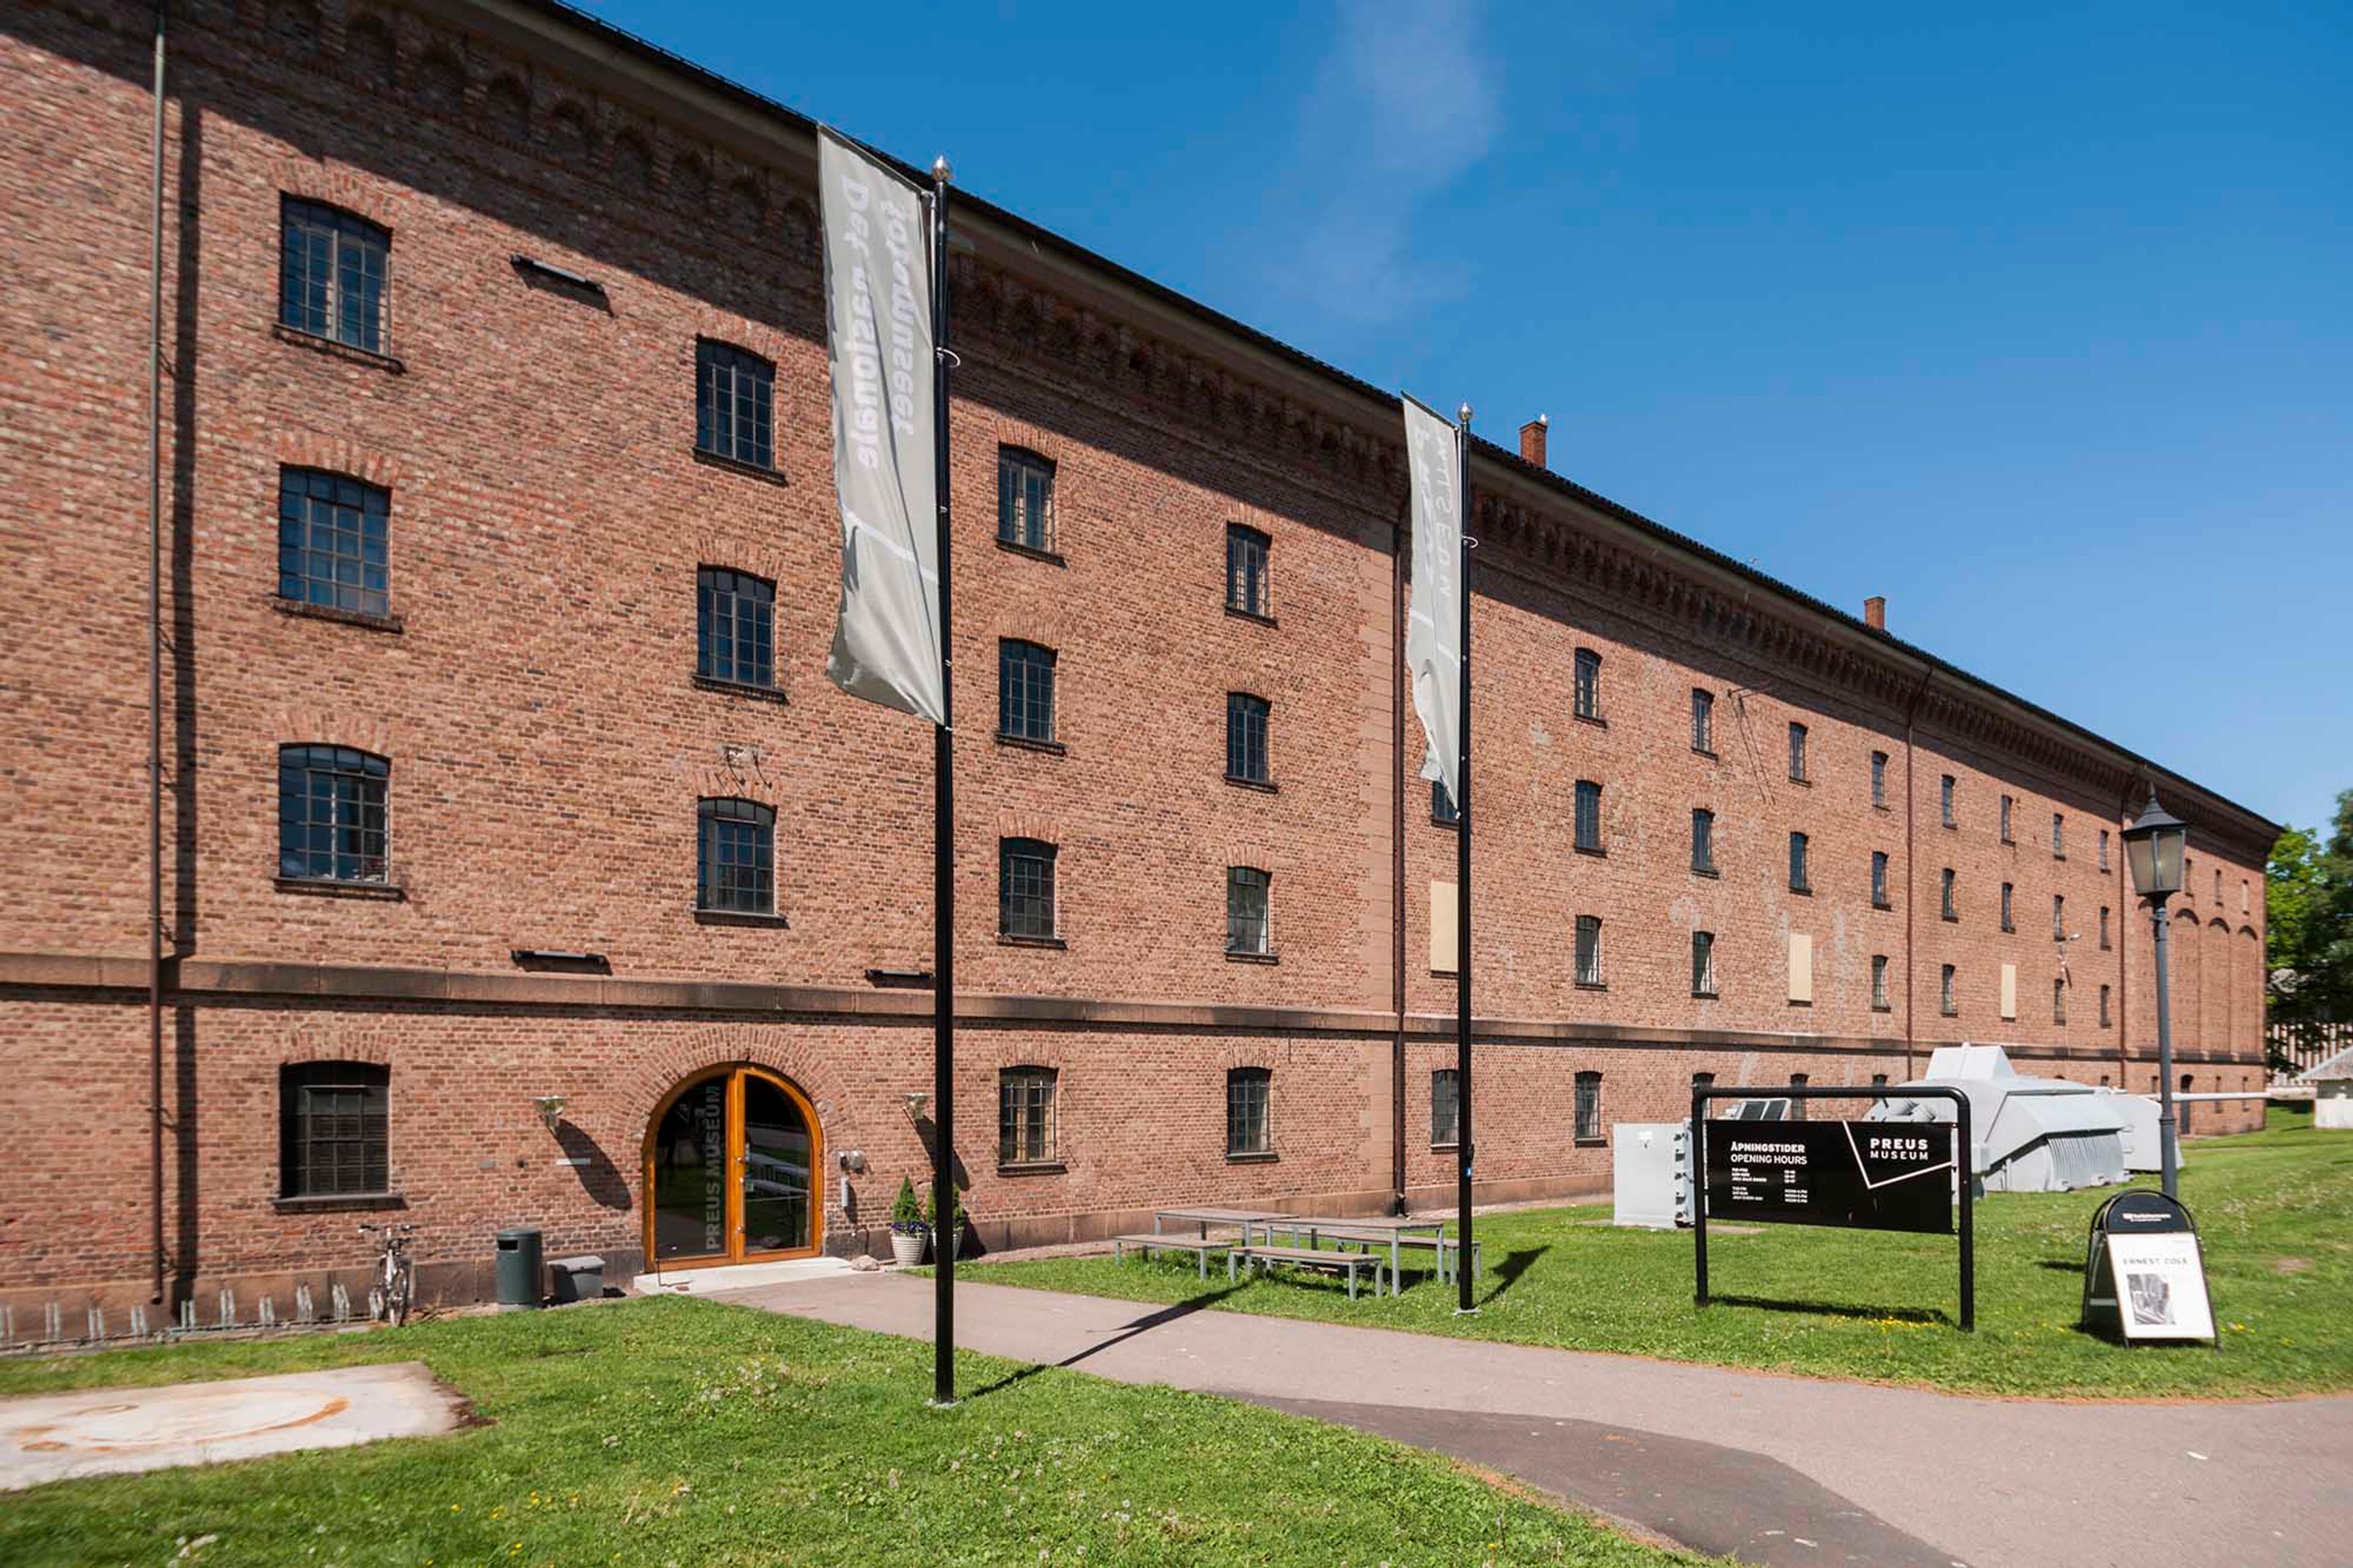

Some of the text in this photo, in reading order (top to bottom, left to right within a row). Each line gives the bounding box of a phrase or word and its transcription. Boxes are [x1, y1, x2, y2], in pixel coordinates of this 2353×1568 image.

[1870, 1138, 1928, 1150] PREUS
[1730, 1154, 1808, 1165] OPENING HOURS
[1870, 1150, 1928, 1161] MUSEUM
[706, 1085, 721, 1250] PREUS MUSEUM
